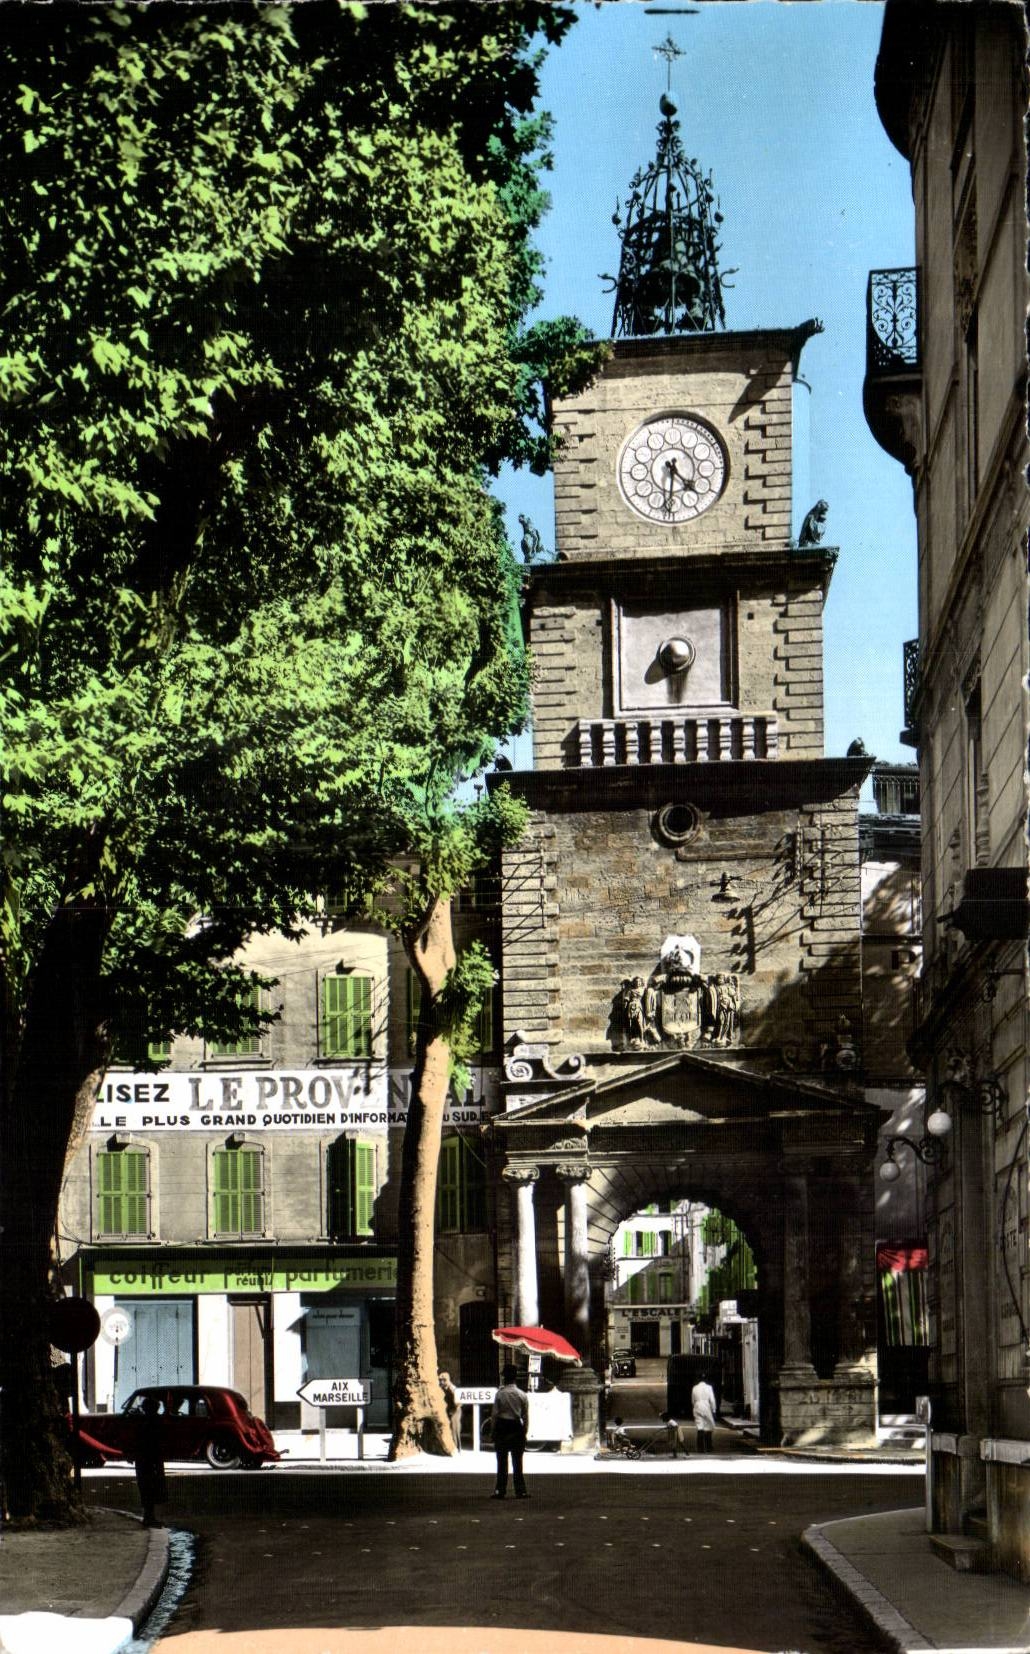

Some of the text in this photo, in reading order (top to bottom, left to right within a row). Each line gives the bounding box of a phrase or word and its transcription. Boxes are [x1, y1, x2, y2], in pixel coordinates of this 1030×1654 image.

[188, 1077, 244, 1111] LE
[255, 1074, 486, 1111] PROVNAL
[100, 1116, 127, 1127] LE
[142, 1115, 190, 1126] PLUS
[201, 1114, 257, 1125] GRAND
[262, 1113, 336, 1127] QUOTIDIEN
[109, 1262, 212, 1289] coiffeur
[286, 1258, 396, 1291] parfumeri
[331, 1382, 349, 1391] AIX
[313, 1393, 368, 1402] MARSEILLE
[460, 1391, 491, 1401] ARLES
